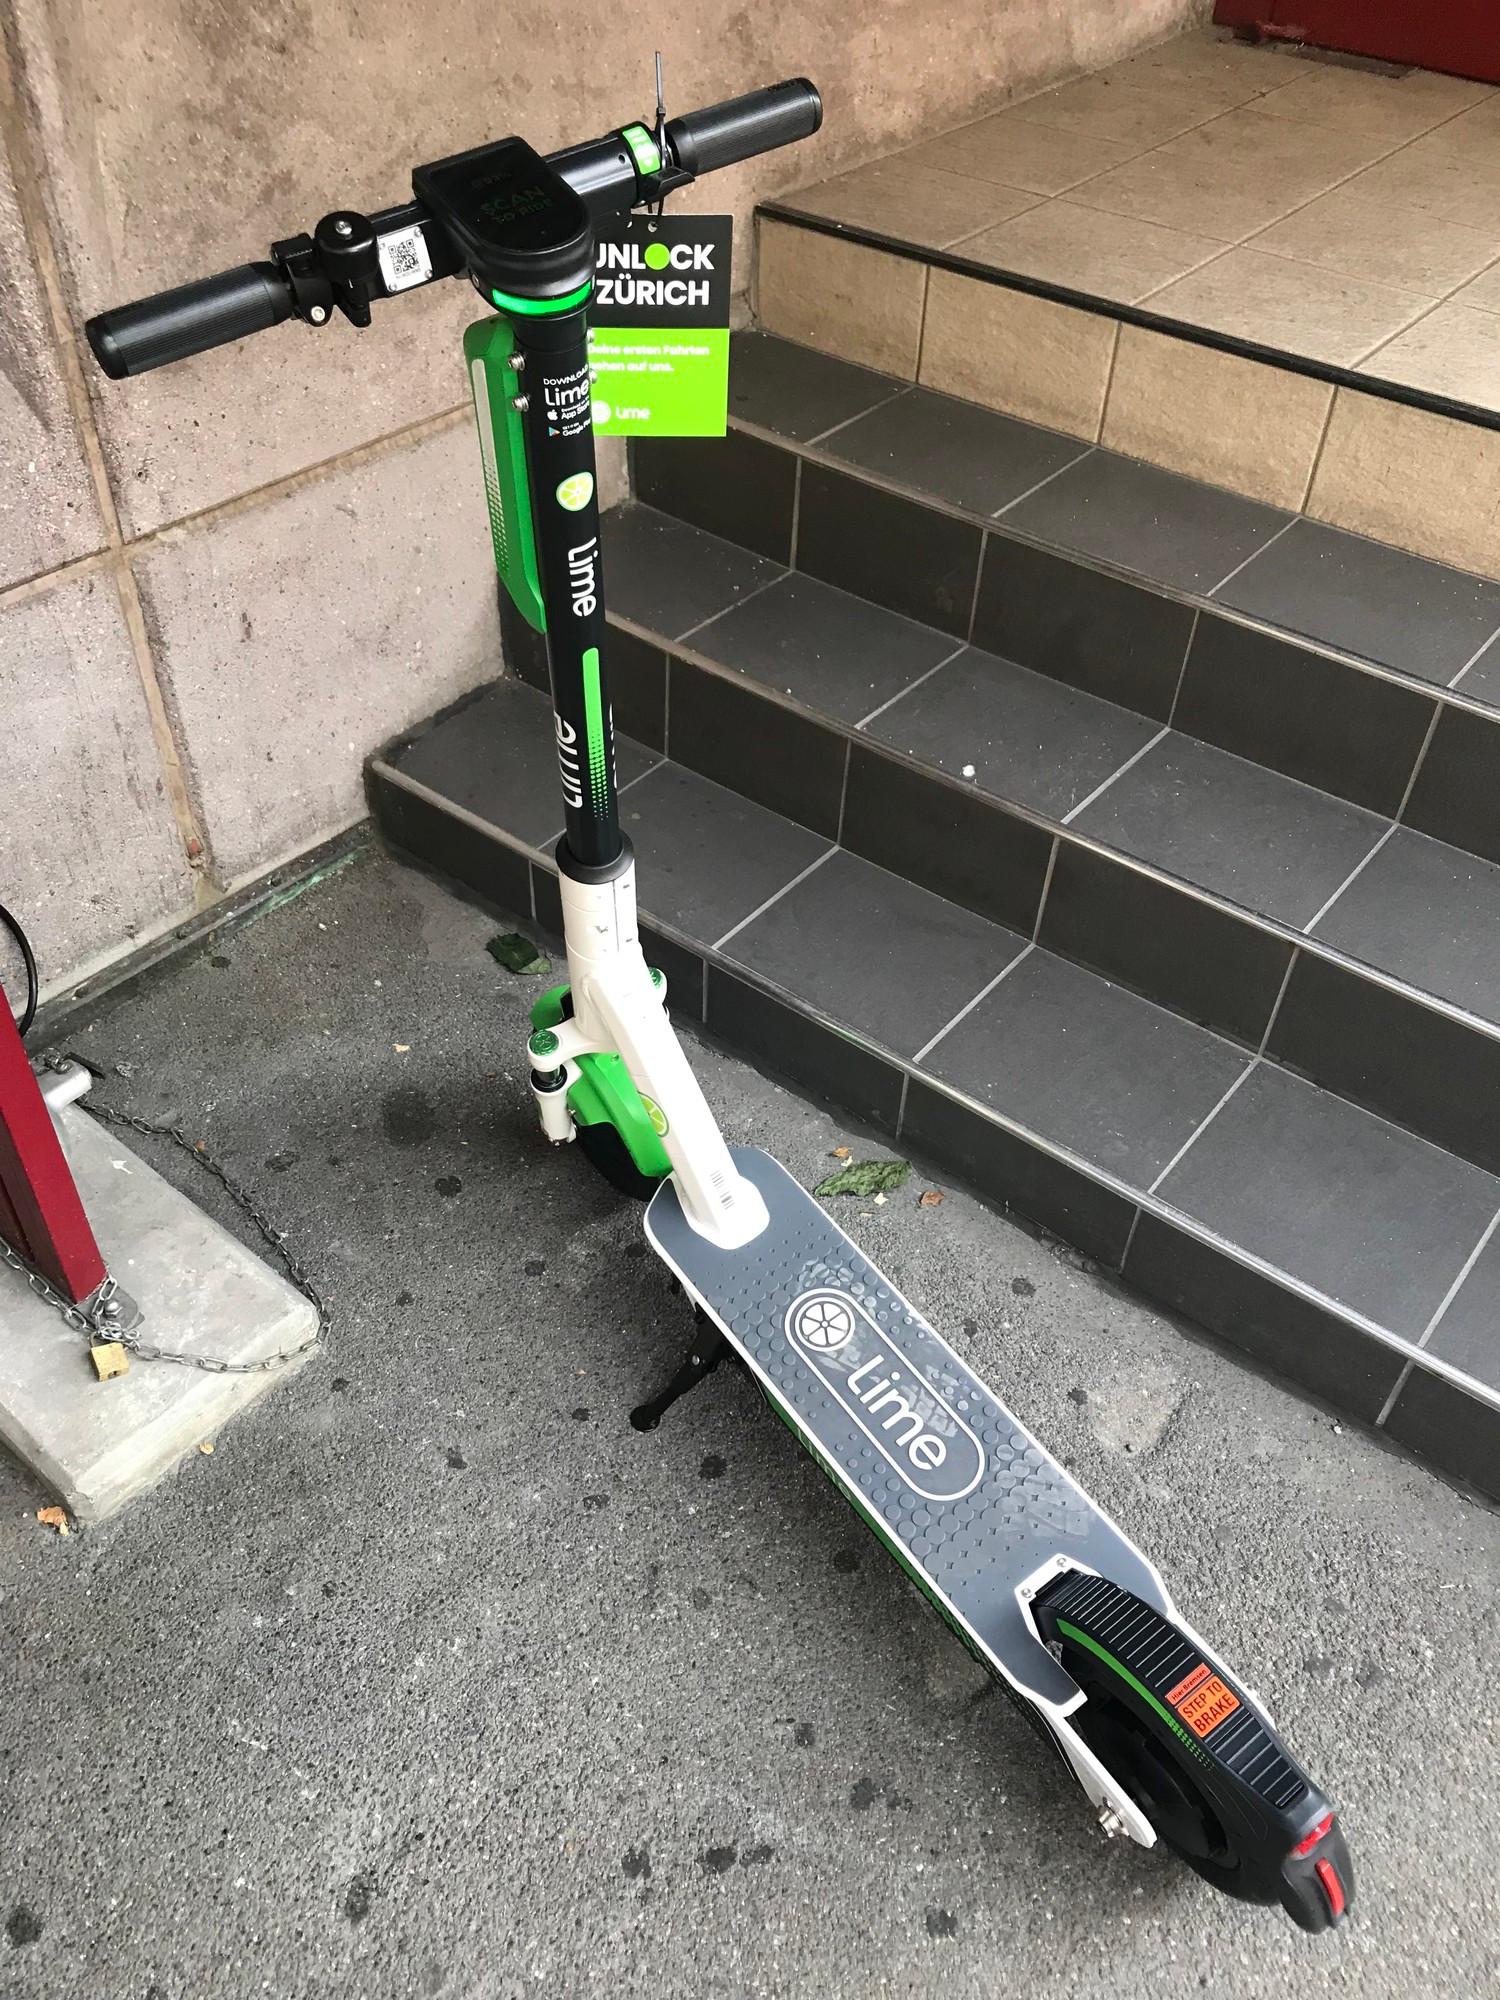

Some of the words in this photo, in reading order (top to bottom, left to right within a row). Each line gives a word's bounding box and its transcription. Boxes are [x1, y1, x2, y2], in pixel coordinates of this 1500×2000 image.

[480, 184, 546, 217] SCAN
[596, 273, 710, 306] ZÜRICH
[623, 345, 662, 356] ersten
[663, 344, 710, 356] Fahrten
[626, 361, 647, 372] auf
[544, 380, 589, 406] Lime
[561, 411, 577, 420] App
[568, 536, 599, 617] Lime
[847, 1354, 947, 1471] Lime
[1171, 1688, 1184, 1701] Hier
[1183, 1669, 1207, 1690] Bremsen
[1183, 1692, 1208, 1718] STEP
[1206, 1680, 1223, 1697] TO
[1193, 1692, 1236, 1732] BRAKE
